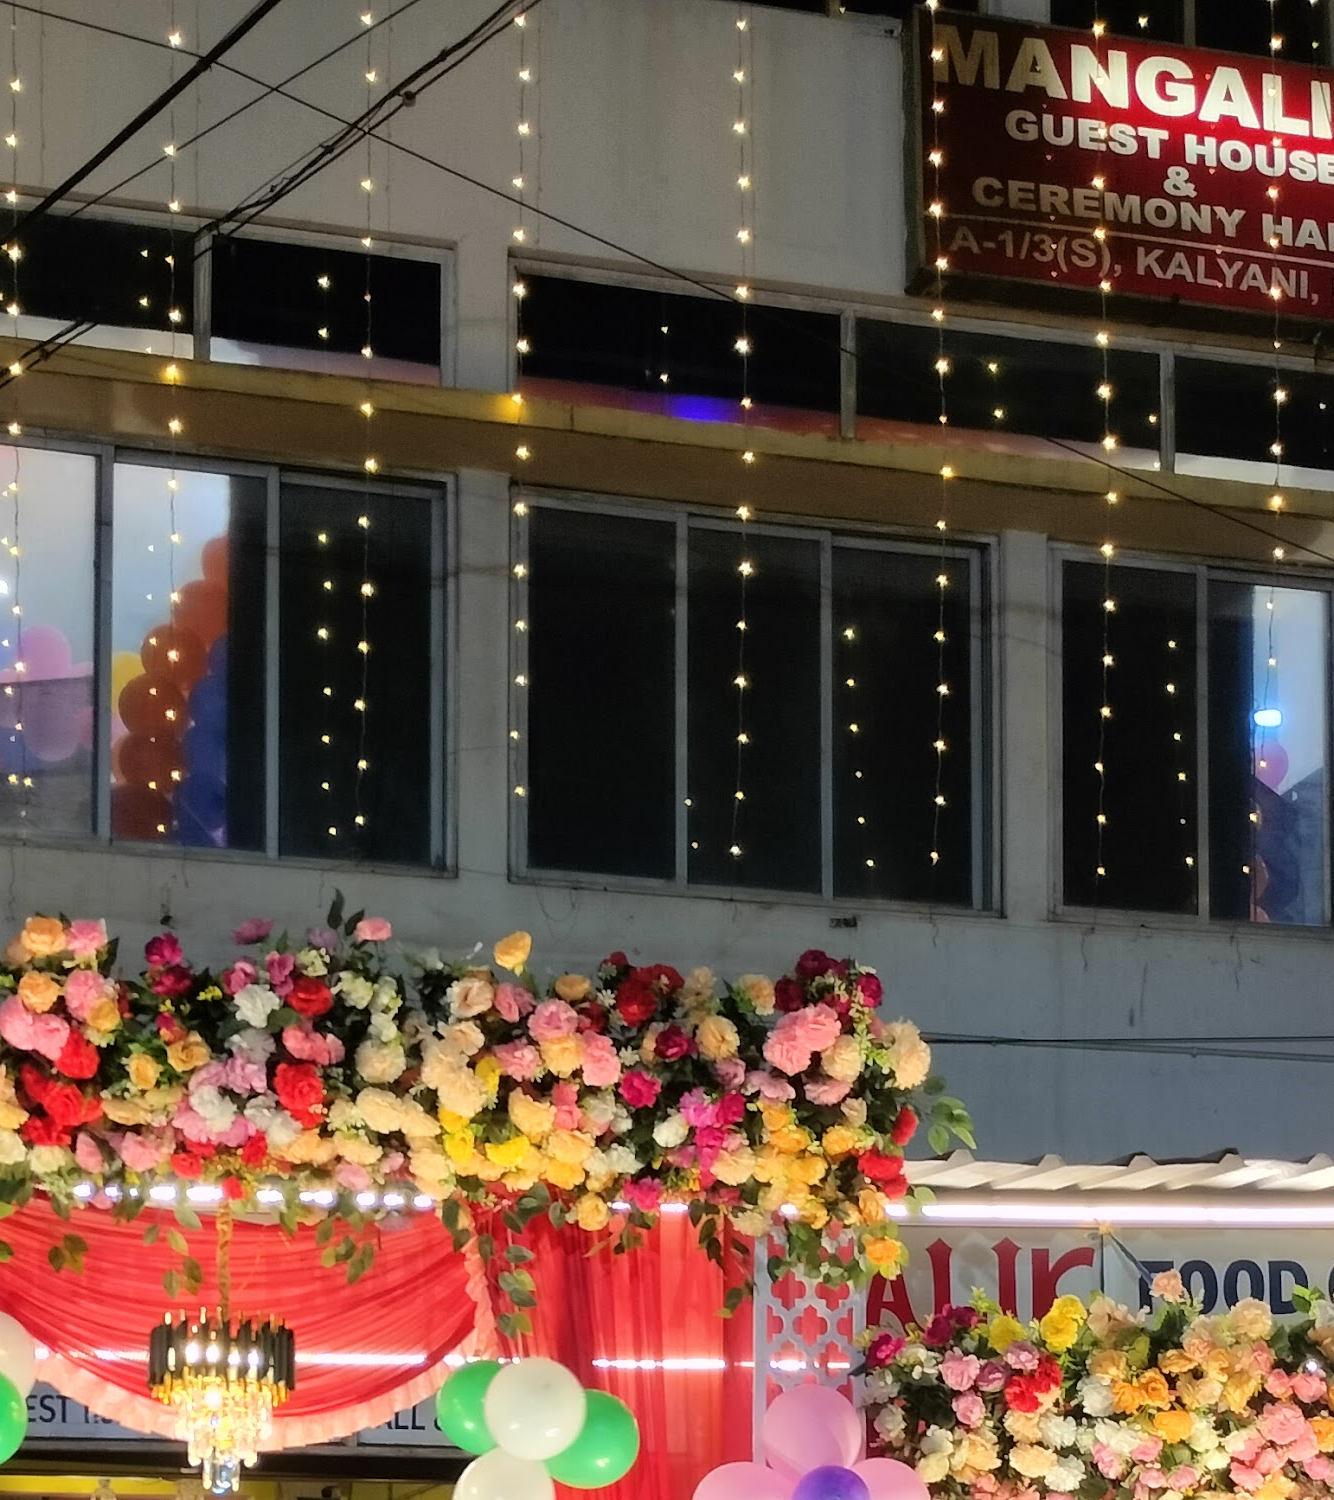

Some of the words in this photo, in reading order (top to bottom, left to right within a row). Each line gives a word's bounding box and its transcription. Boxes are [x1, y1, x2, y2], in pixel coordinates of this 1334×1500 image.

[1005, 109, 1169, 160] GUEST
[972, 176, 1246, 237] CEREMONY
[1163, 165, 1198, 198] &
[949, 226, 1123, 278] A-1/3(S),
[1136, 246, 1319, 306] KALYANI,
[1139, 1259, 1310, 1316] FOOD
